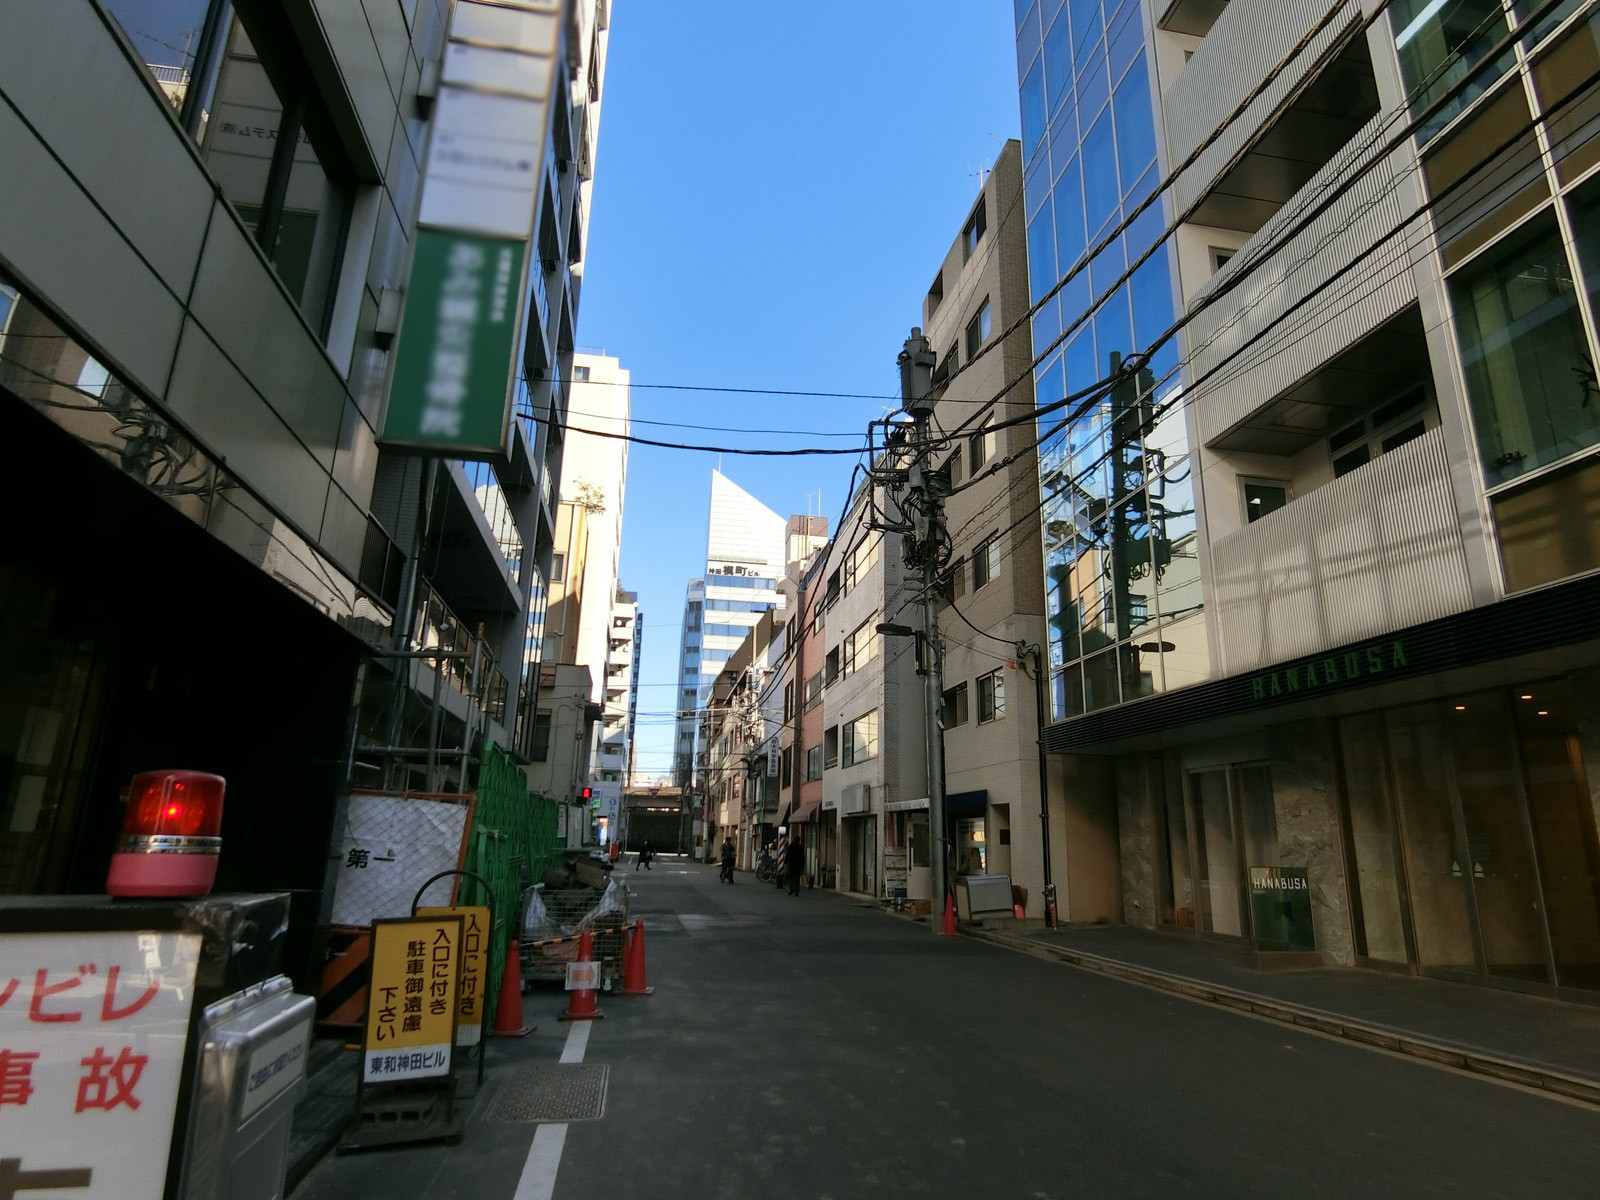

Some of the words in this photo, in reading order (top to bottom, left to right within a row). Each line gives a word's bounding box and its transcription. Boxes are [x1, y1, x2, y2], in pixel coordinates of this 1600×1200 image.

[1252, 641, 1408, 700] HANABUSA
[1253, 877, 1308, 890] HANABUSA
[401, 940, 427, 1033] 駐車御遠慮
[429, 928, 451, 1016] 入口に付き
[460, 914, 482, 1017] 入口に付き
[376, 986, 400, 1042] 下さい
[369, 1051, 447, 1075] 東和神田ビル
